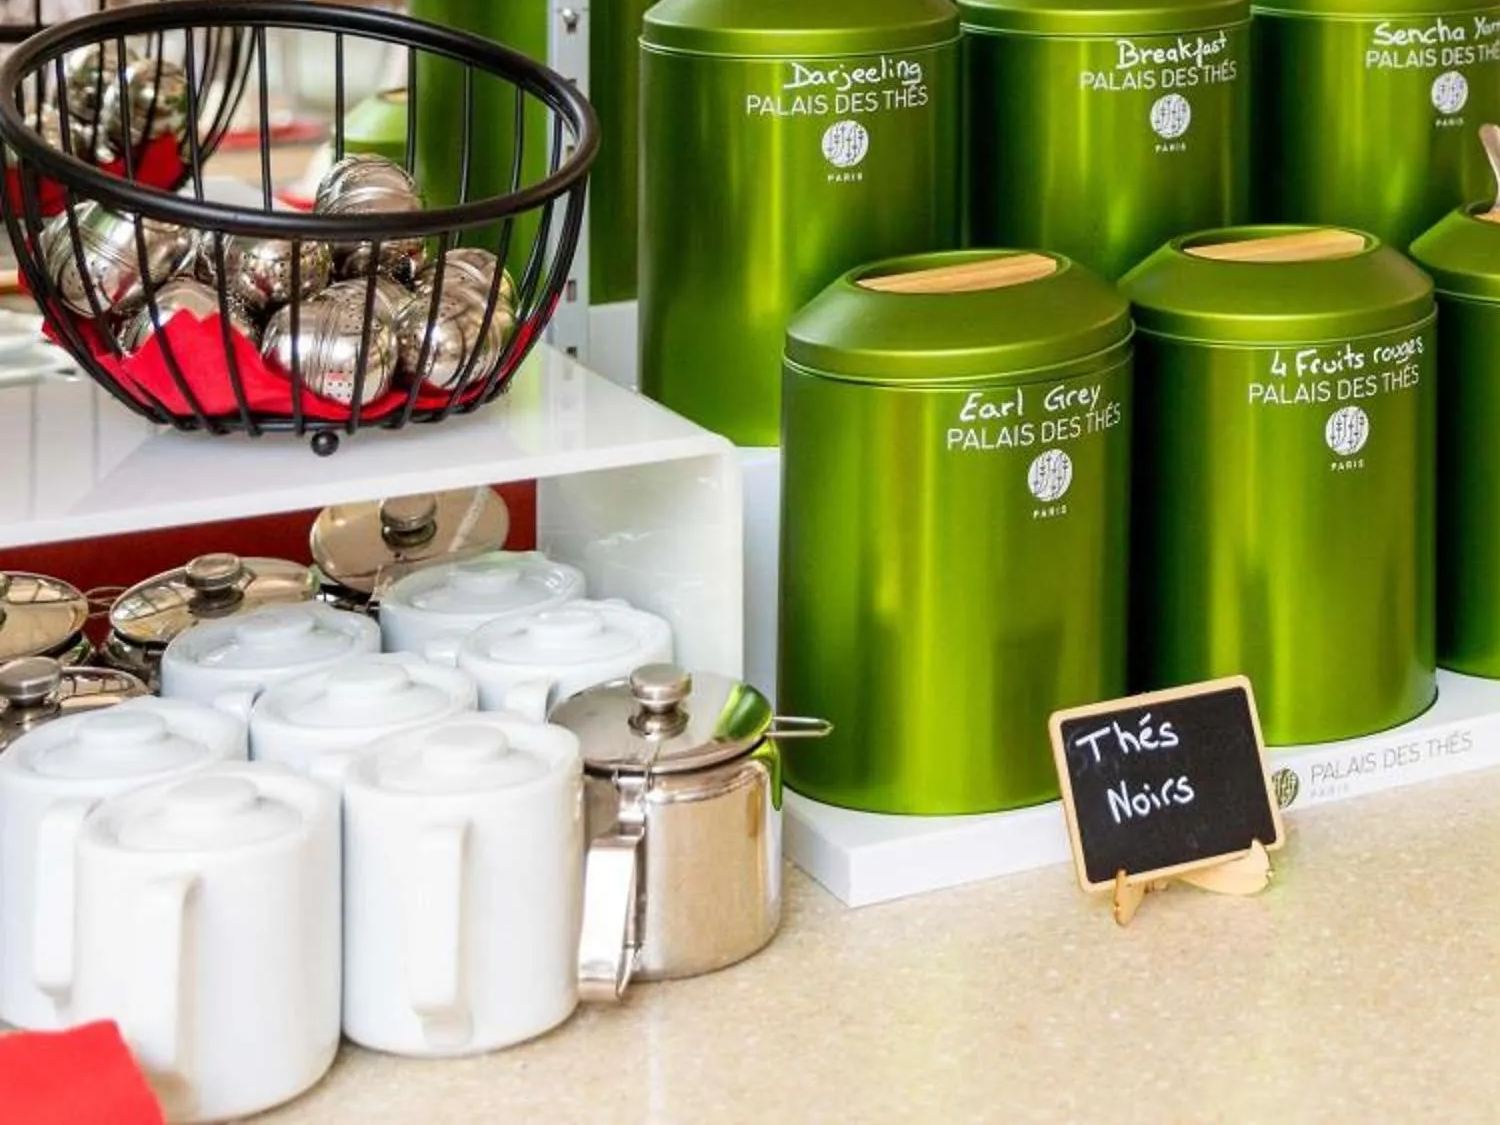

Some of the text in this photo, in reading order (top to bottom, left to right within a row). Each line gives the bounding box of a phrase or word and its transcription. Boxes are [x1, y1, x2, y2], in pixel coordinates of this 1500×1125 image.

[1115, 30, 1227, 70] Breakfast
[1373, 17, 1465, 46] Sencha
[783, 55, 923, 91] Darjeeling
[1080, 59, 1238, 91] PALAIS DES THÉS
[1365, 49, 1437, 68] PALAIS
[1441, 46, 1475, 65] DES
[746, 94, 829, 116] PALAIS
[835, 91, 879, 114] DES
[827, 171, 863, 183] PARIS
[1270, 335, 1425, 377] 4 Fruits rouges
[1249, 364, 1420, 404] PALAIS DES THÉS
[960, 384, 1101, 422] Earl Grey
[947, 402, 1121, 451] PALAIS DES THÉS
[1330, 458, 1365, 472] PARIS
[1032, 504, 1068, 519] PARIS
[1075, 713, 1180, 763] Thés
[1310, 728, 1474, 785] PALAIS DES THÉS
[1106, 775, 1196, 825] Noirs
